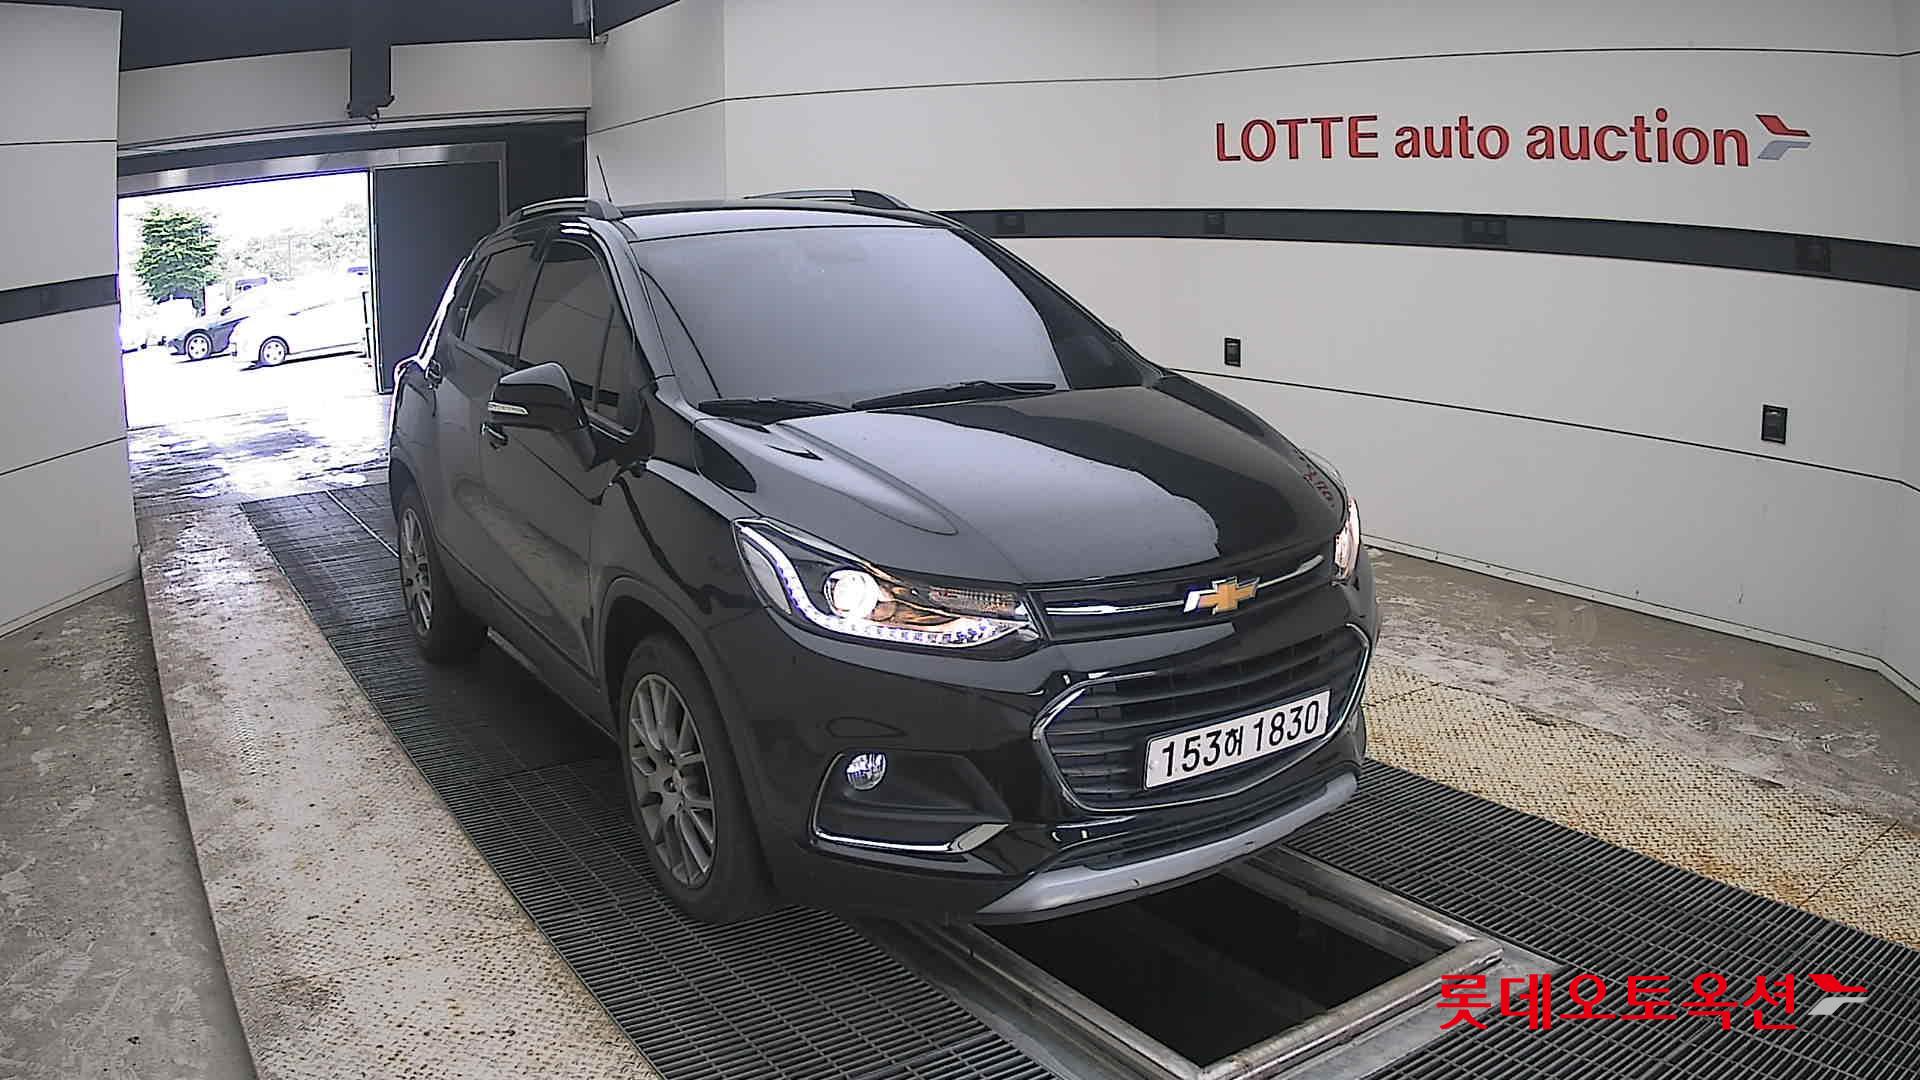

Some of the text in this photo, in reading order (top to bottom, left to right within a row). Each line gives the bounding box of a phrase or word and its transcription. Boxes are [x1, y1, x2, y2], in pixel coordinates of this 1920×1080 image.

[1215, 107, 1750, 167] LOTTE auto auction
[1162, 700, 1320, 777] 153허 1830
